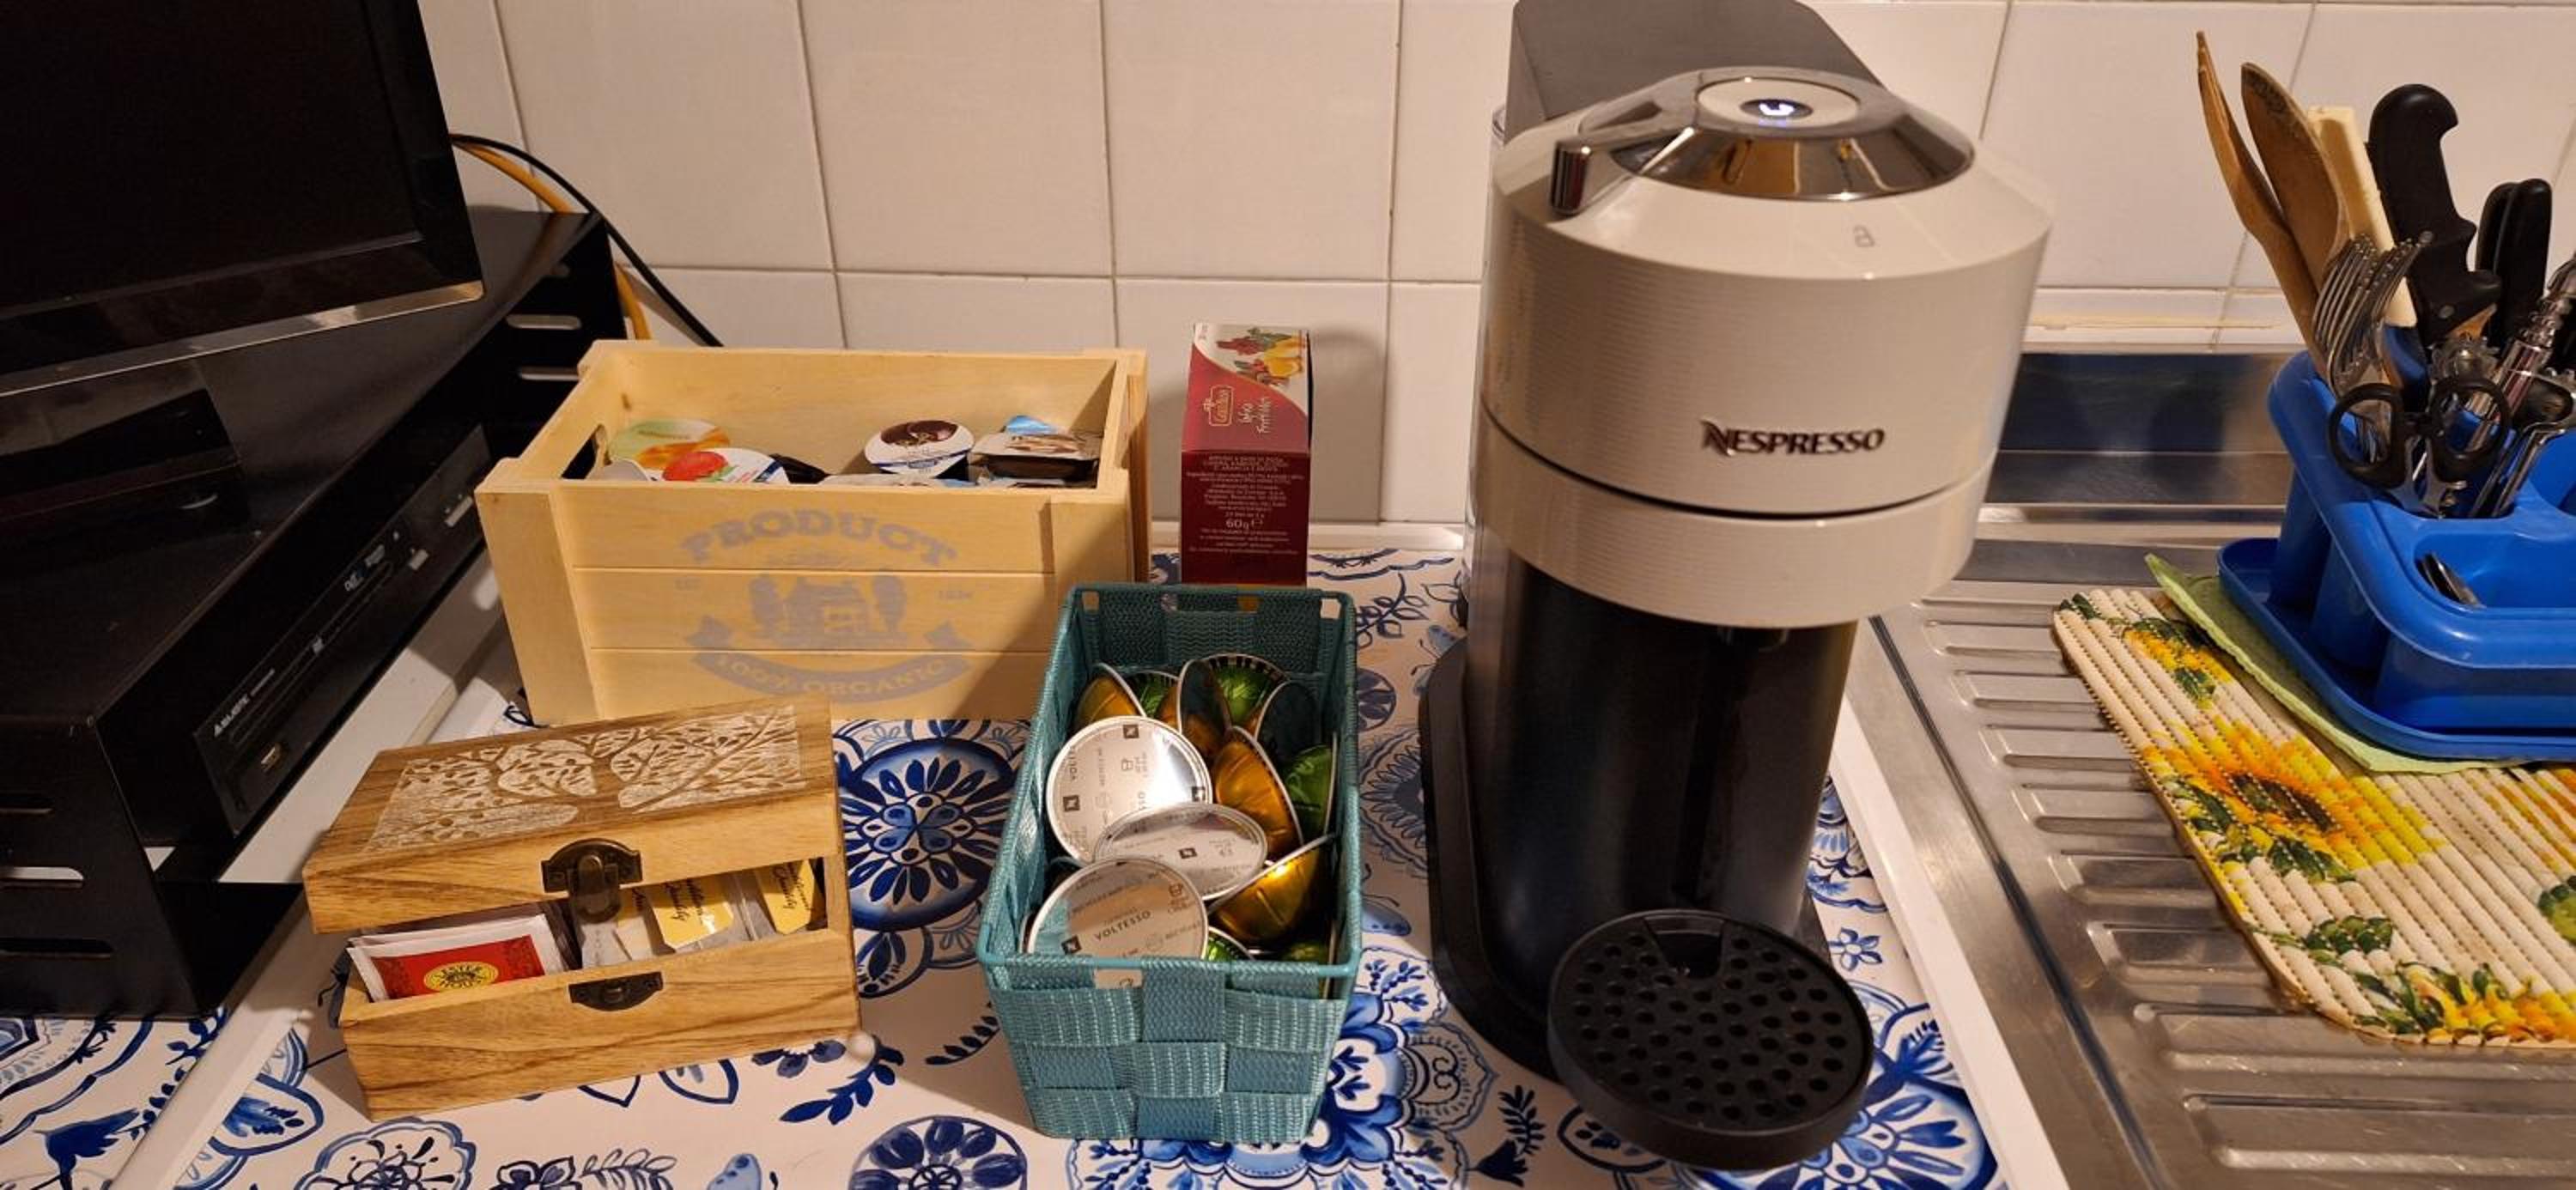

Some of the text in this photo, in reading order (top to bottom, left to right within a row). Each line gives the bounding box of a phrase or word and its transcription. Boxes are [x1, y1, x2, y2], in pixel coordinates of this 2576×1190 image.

[1700, 419, 1885, 457] NESPRESSO
[682, 510, 957, 566] PRODUCT
[805, 659, 948, 695] ORGANIC
[1093, 910, 1151, 941] VOLTESSO
